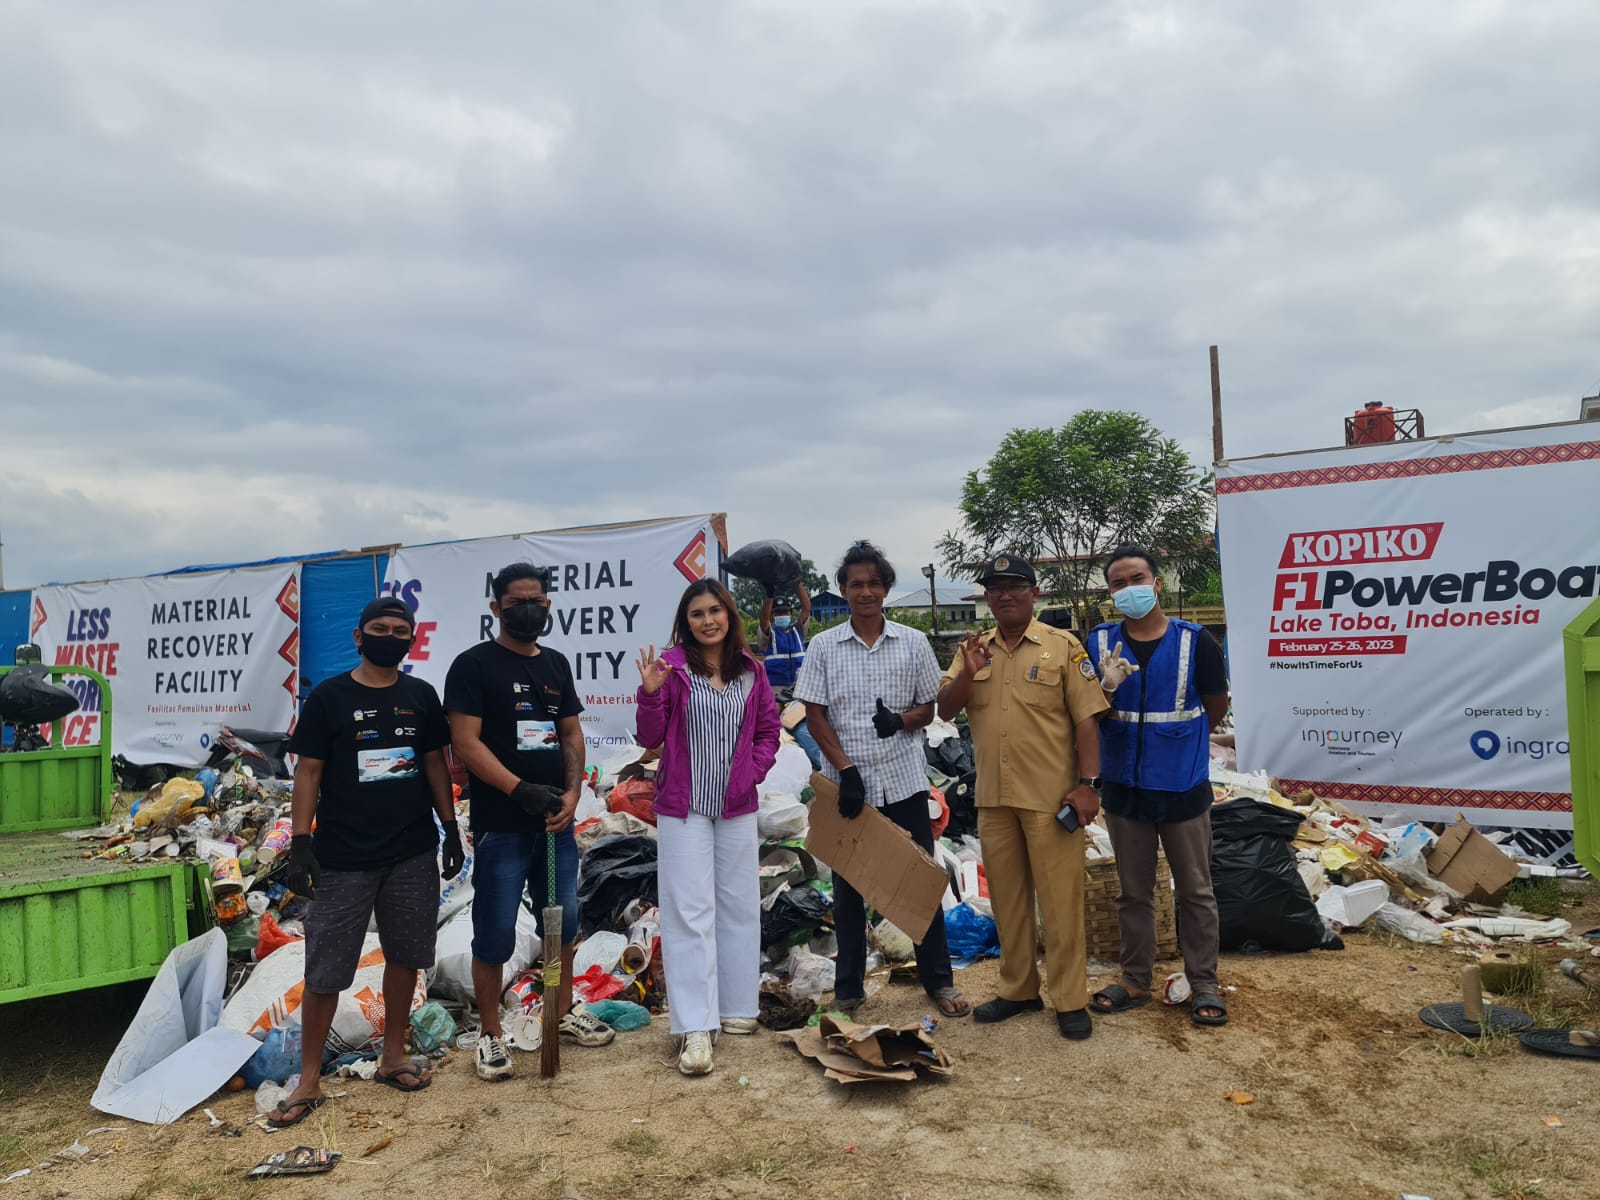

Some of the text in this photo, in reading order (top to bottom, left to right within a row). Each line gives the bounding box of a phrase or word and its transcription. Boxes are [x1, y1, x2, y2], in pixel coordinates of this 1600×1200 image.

[1292, 528, 1427, 564] KOPIKO
[1273, 560, 1600, 612] F1PowerBoa
[151, 596, 251, 625] MATERIAL
[1269, 604, 1540, 633] Lake Toba, Indonesia
[66, 607, 111, 642] LESS
[148, 632, 254, 659] RECOVERY
[1280, 639, 1394, 654] February 25-26, 2023
[1269, 660, 1363, 670] #NowItsTimeForUs
[156, 669, 243, 694] FACILITY
[147, 704, 176, 713] Fasilitas
[215, 702, 251, 713] Material
[585, 693, 638, 705] Material
[1292, 706, 1348, 718] Supported
[1351, 706, 1366, 719] by
[1464, 706, 1523, 719] Operated
[1526, 706, 1542, 719] by
[584, 735, 628, 749] ngram
[1301, 729, 1403, 750] injourney
[1506, 736, 1571, 760] ingra
